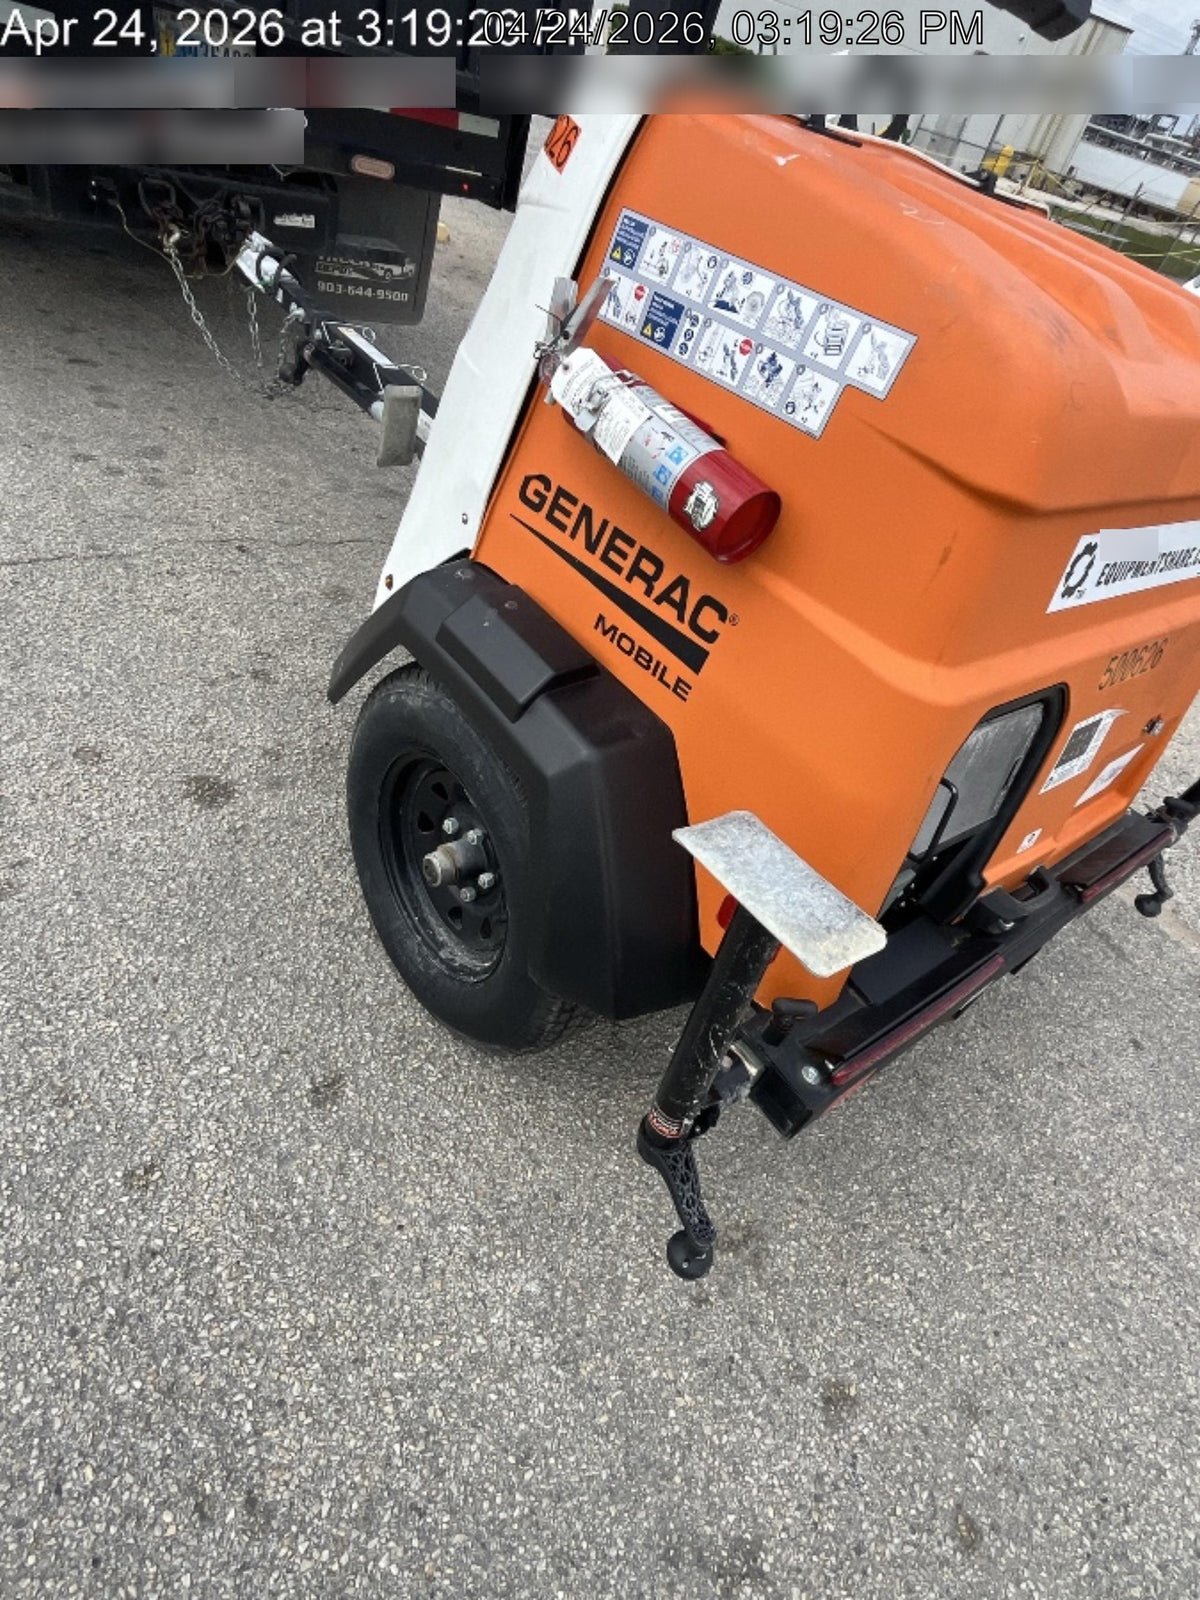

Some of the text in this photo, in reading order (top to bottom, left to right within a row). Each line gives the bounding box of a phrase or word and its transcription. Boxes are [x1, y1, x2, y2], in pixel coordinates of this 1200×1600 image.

[518, 473, 729, 645] GENERAC
[593, 613, 693, 703] MOBILE
[1098, 637, 1169, 691] 500626
